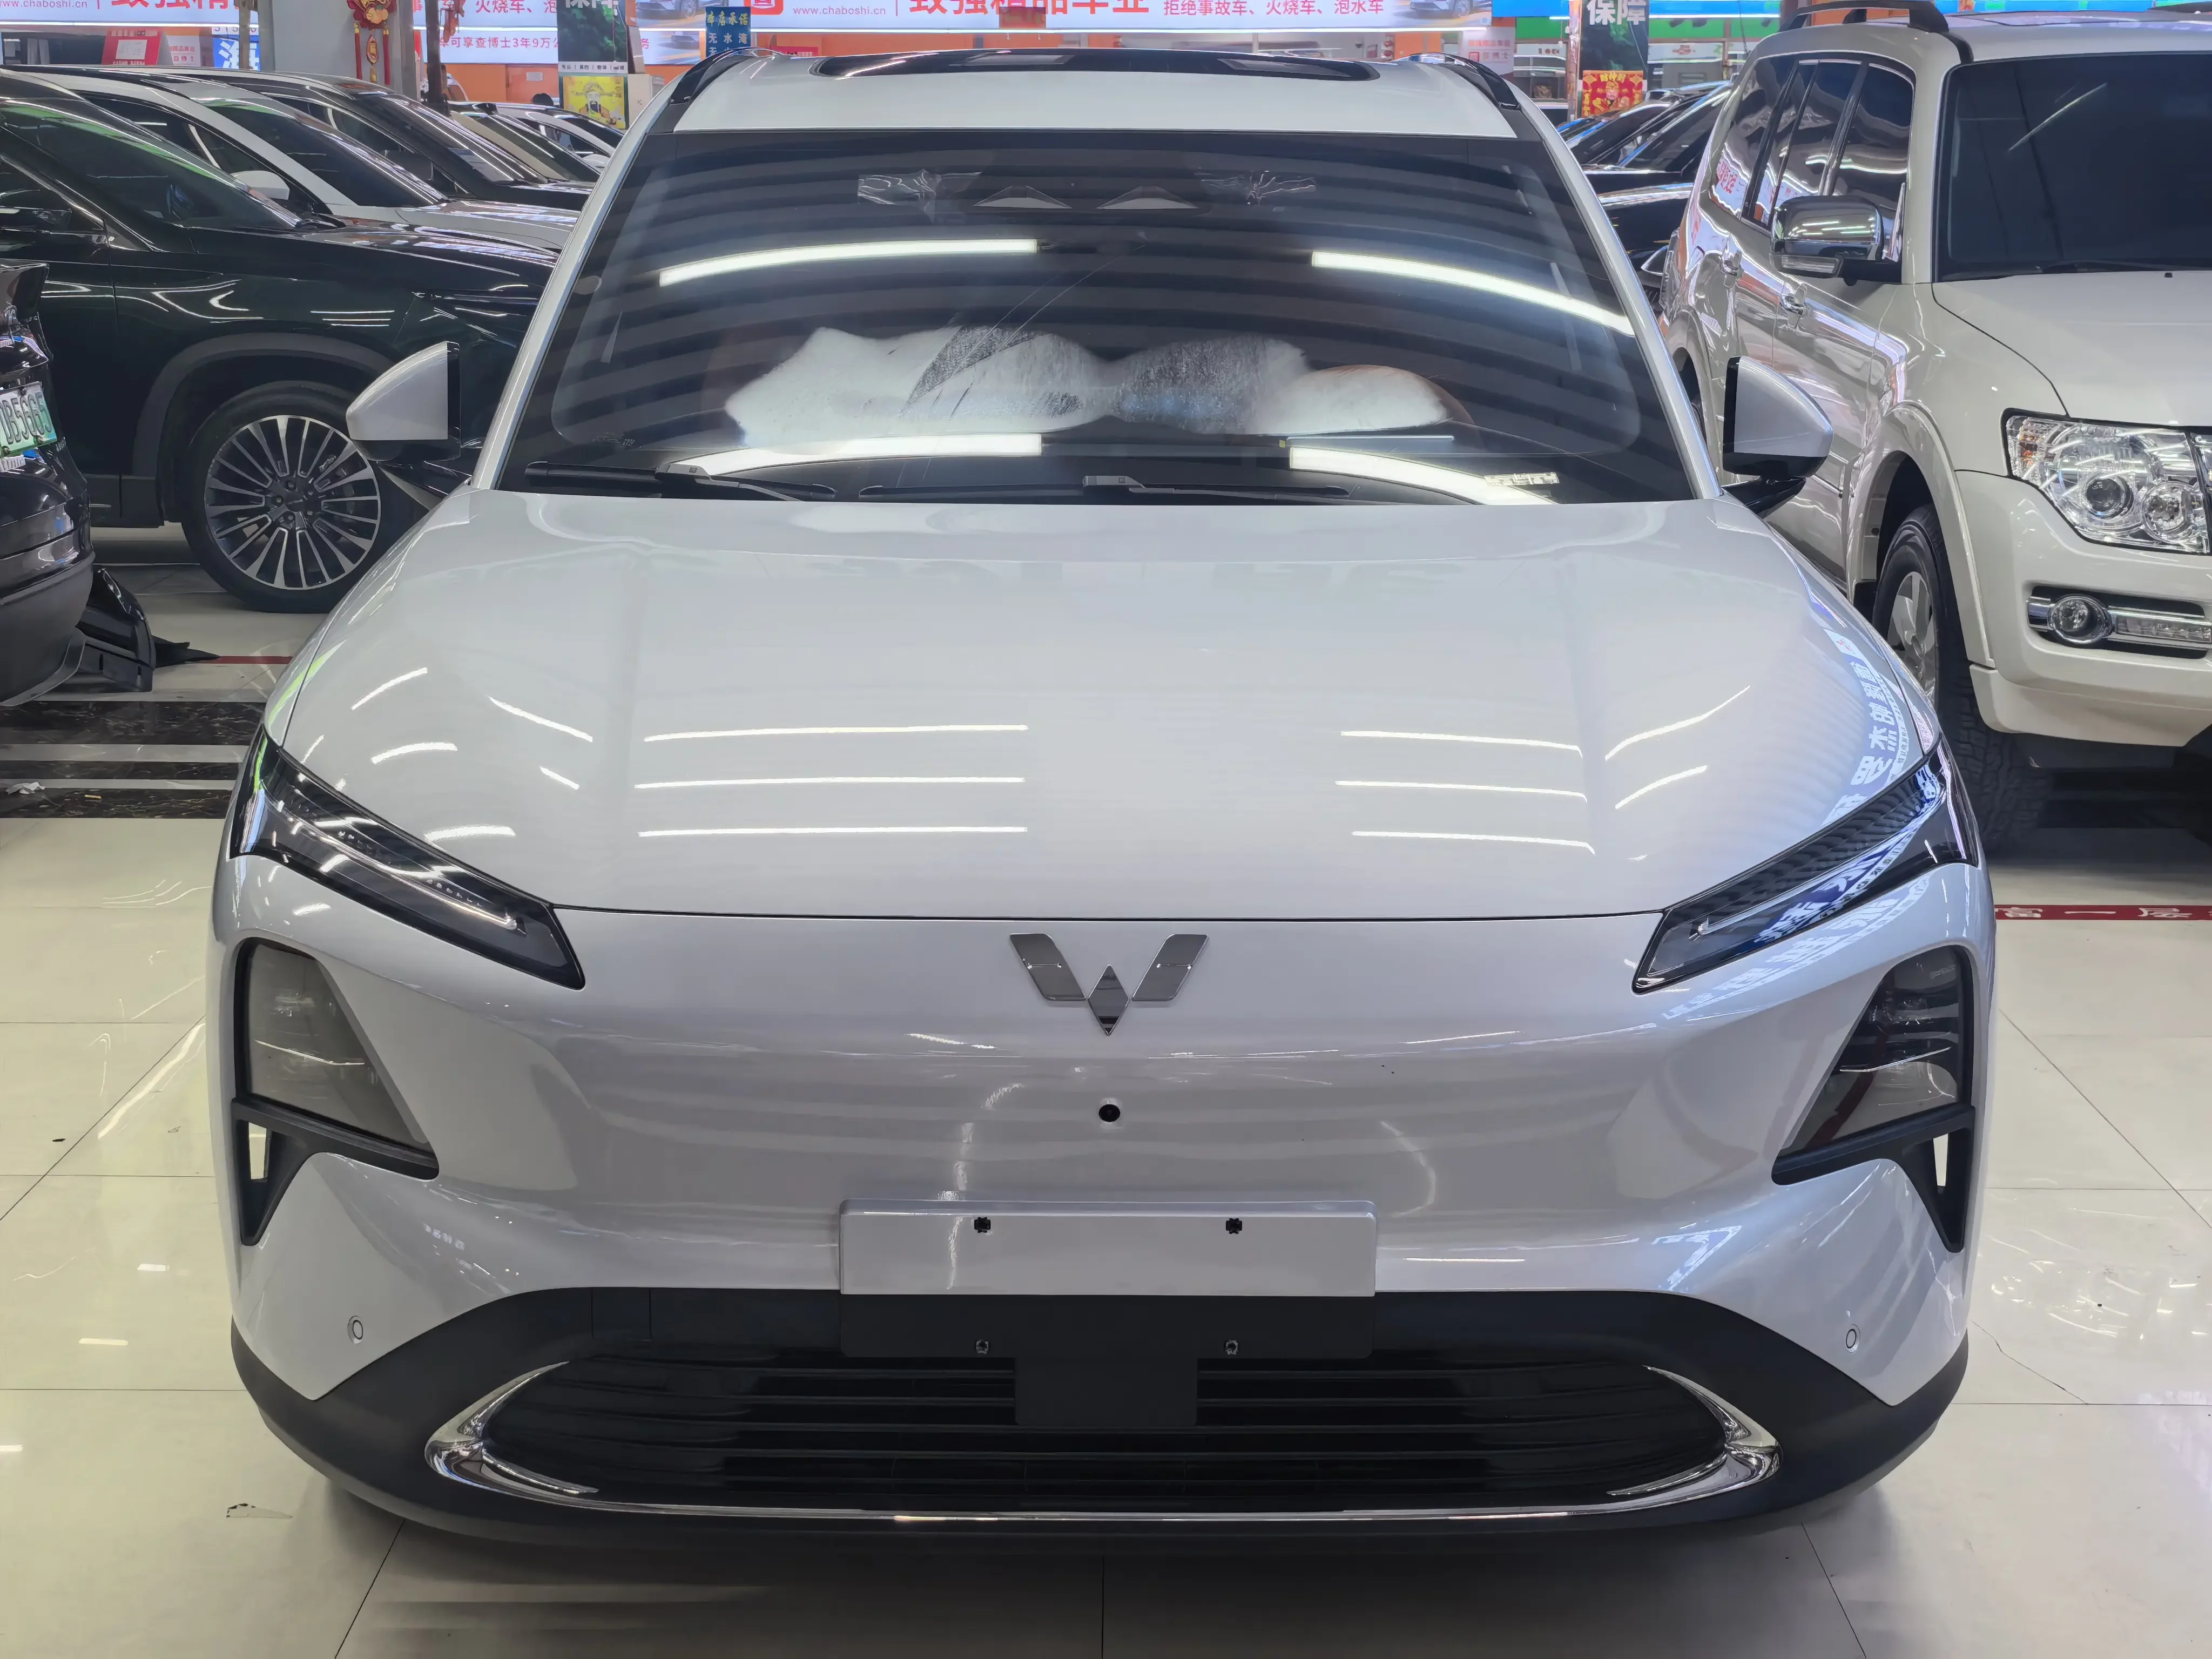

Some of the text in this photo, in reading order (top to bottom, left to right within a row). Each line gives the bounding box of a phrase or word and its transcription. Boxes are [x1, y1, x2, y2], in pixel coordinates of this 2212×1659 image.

[793, 6, 886, 15] www.chaboshi.cn
[1163, 0, 1384, 16] 拒绝事故车、火烧车、泡水车
[1586, 0, 1646, 25] 保障
